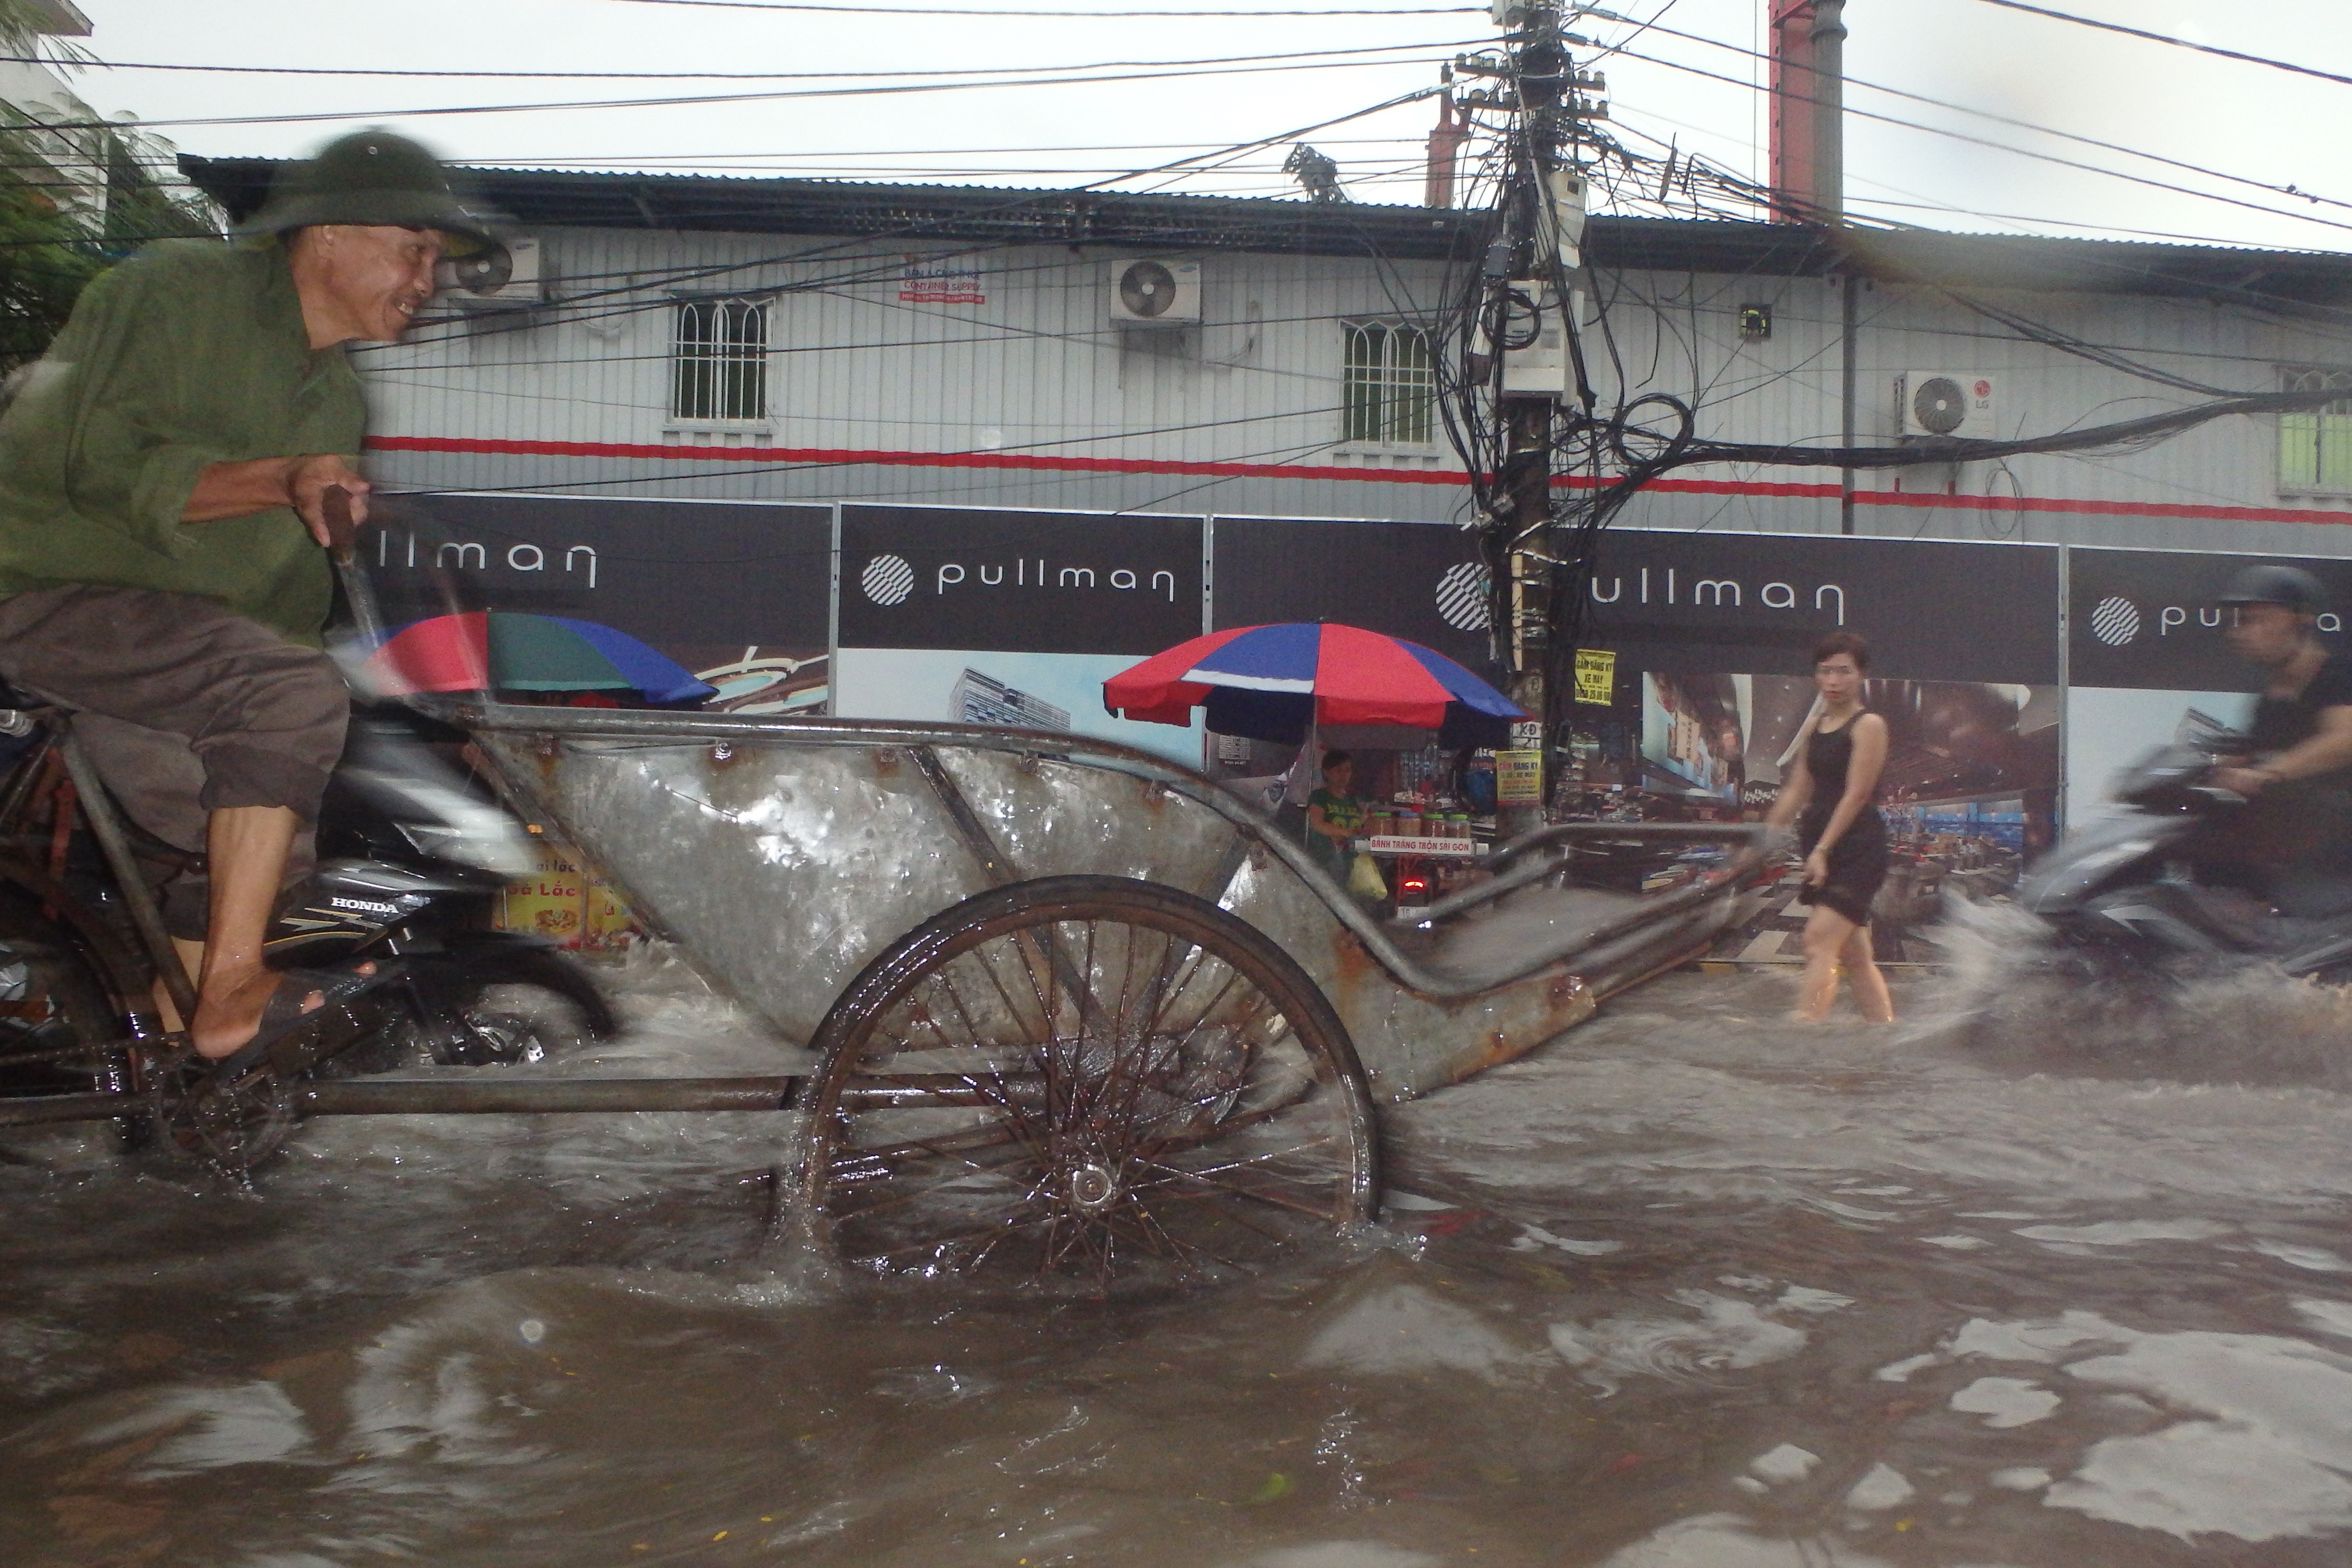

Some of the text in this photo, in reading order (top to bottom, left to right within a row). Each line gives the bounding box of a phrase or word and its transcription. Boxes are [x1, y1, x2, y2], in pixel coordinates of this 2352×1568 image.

[379, 530, 597, 589] llman
[938, 558, 1174, 602] pullman
[1591, 567, 1845, 626] ullman
[331, 897, 399, 914] HONDA
[540, 880, 576, 897] Lắc
